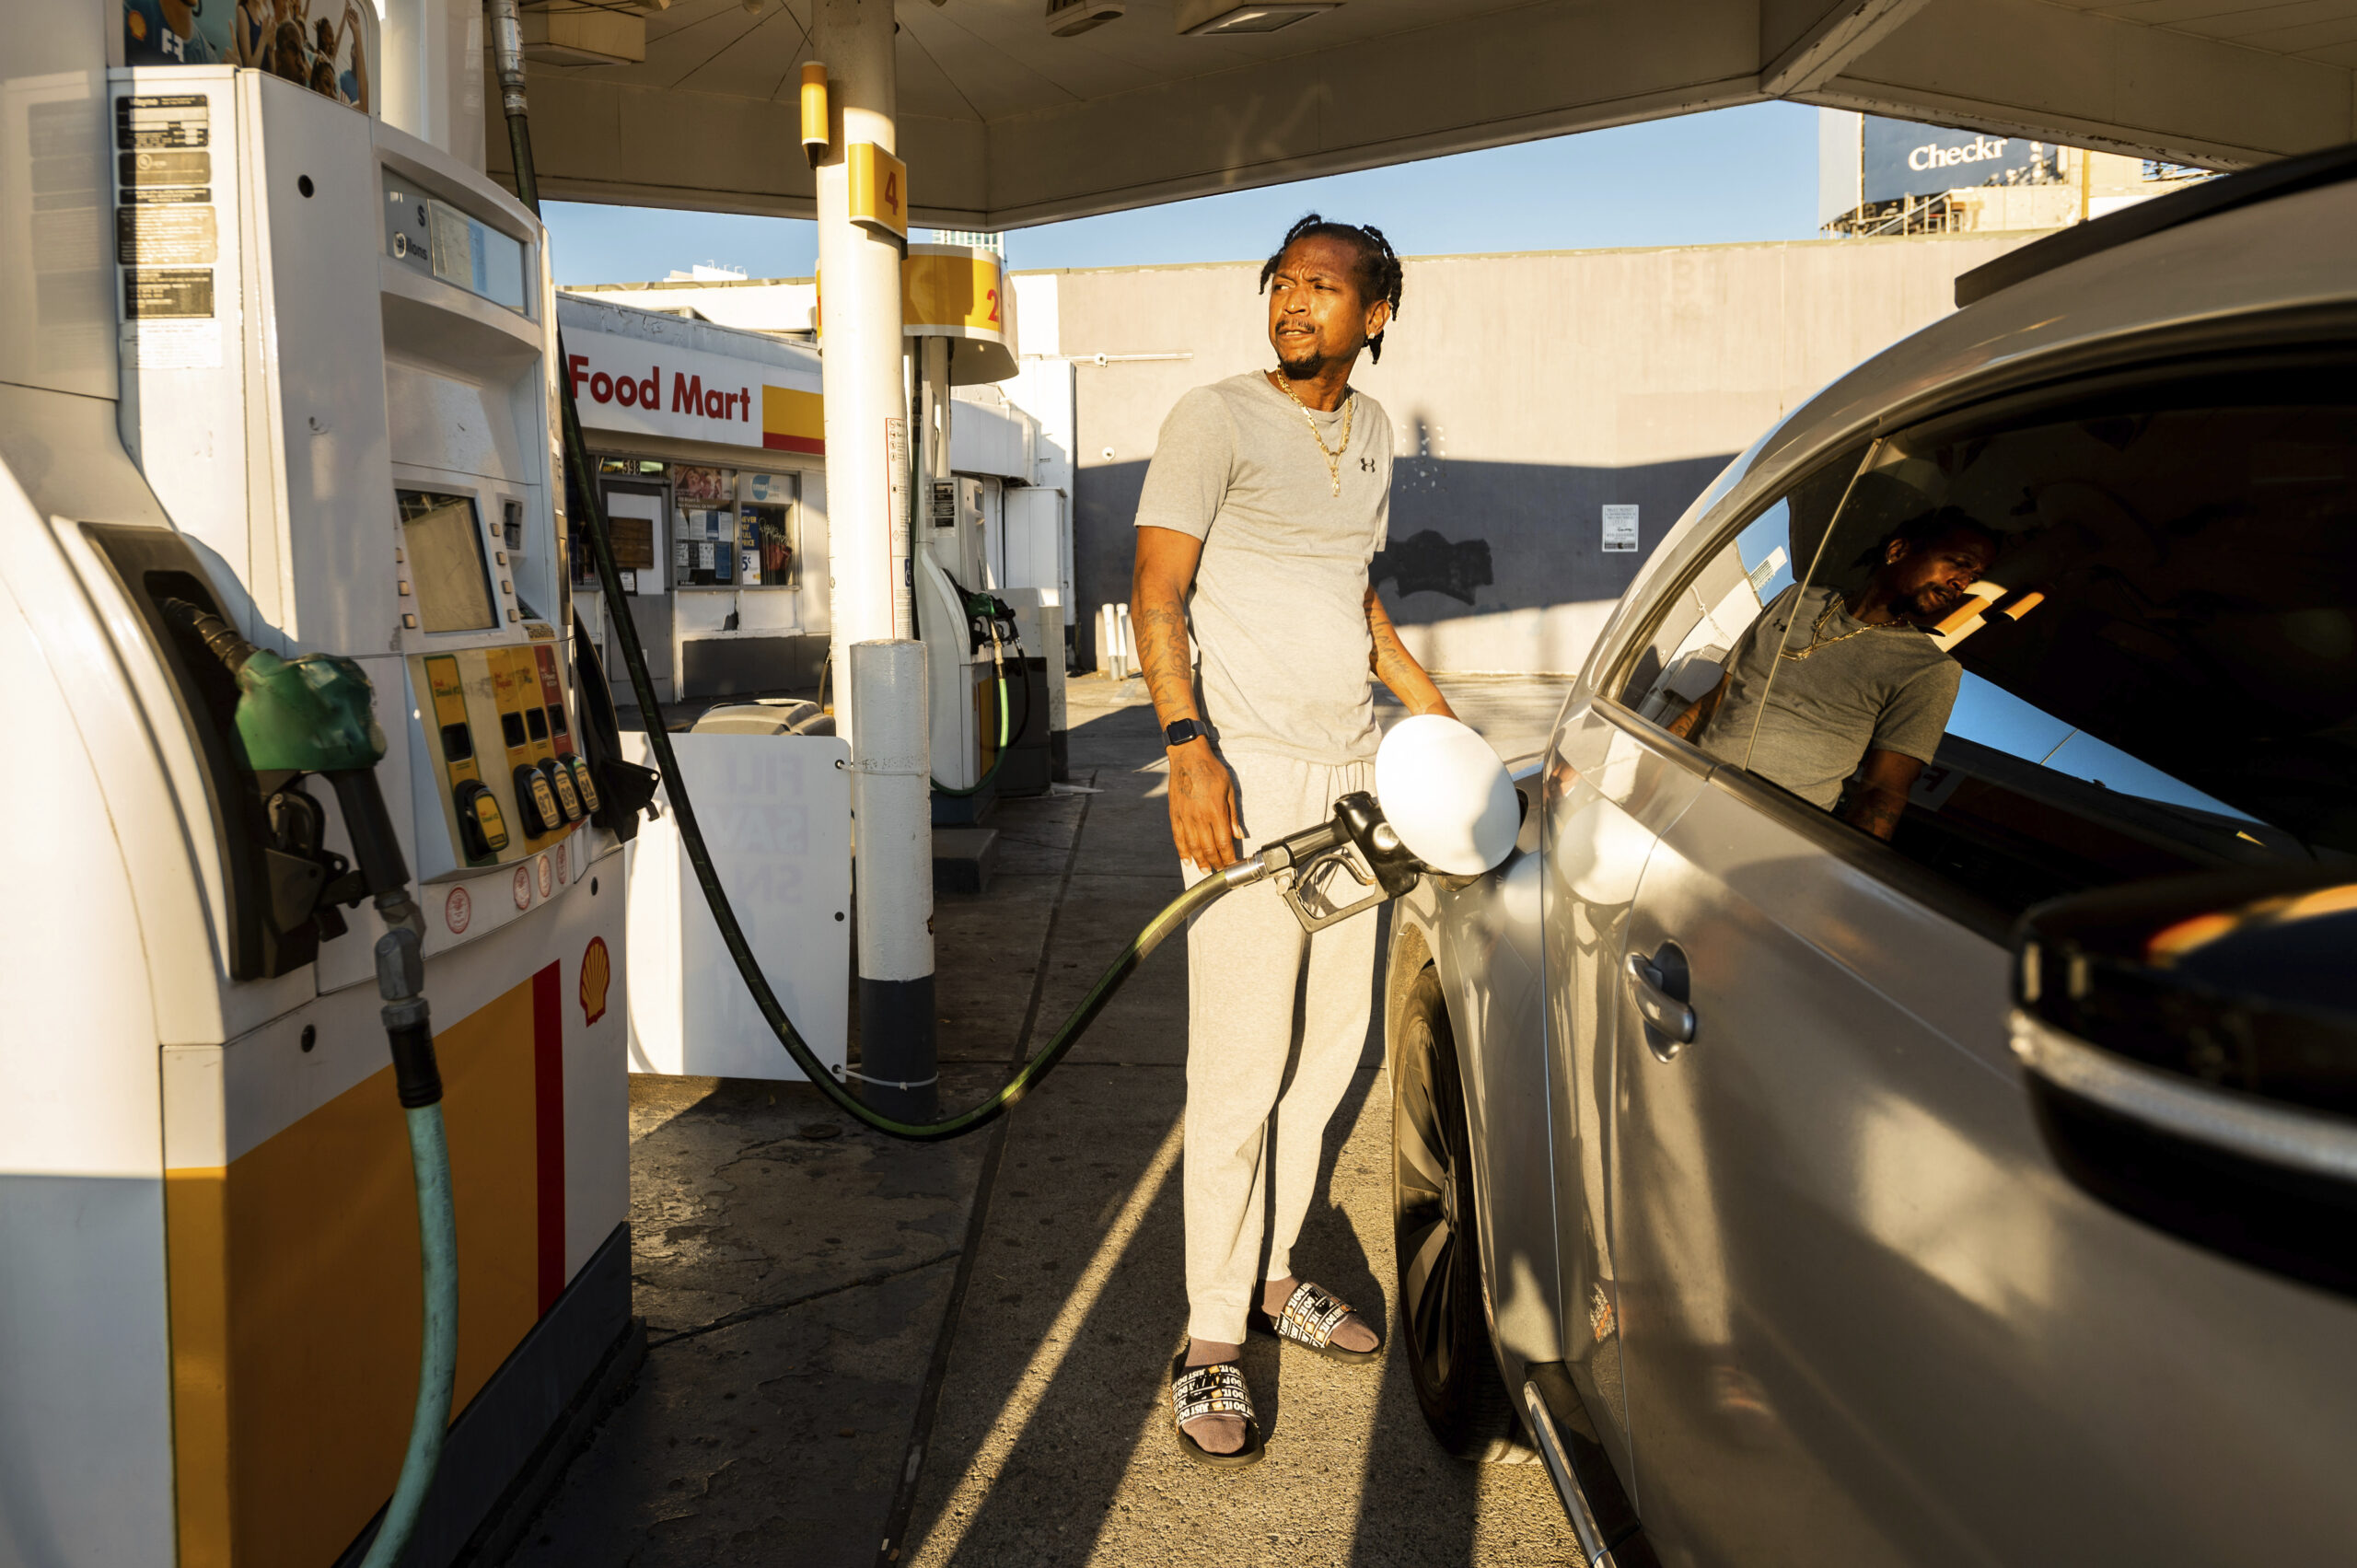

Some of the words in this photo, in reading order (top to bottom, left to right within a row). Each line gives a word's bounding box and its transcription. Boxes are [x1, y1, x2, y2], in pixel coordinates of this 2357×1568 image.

[1908, 135, 2008, 171] Checkr
[884, 171, 899, 215] 4
[986, 288, 1000, 321] 2
[568, 354, 660, 411] Food
[672, 372, 750, 423] Mart
[622, 459, 641, 475] 598
[560, 786, 575, 807] 89
[580, 779, 595, 798] 91
[538, 793, 553, 815] 87
[1188, 1368, 1205, 1381] JUST
[1232, 1390, 1244, 1400] DO
[1179, 1409, 1190, 1421] DO
[1190, 1402, 1209, 1415] JUST
[1234, 1401, 1246, 1412] DO
